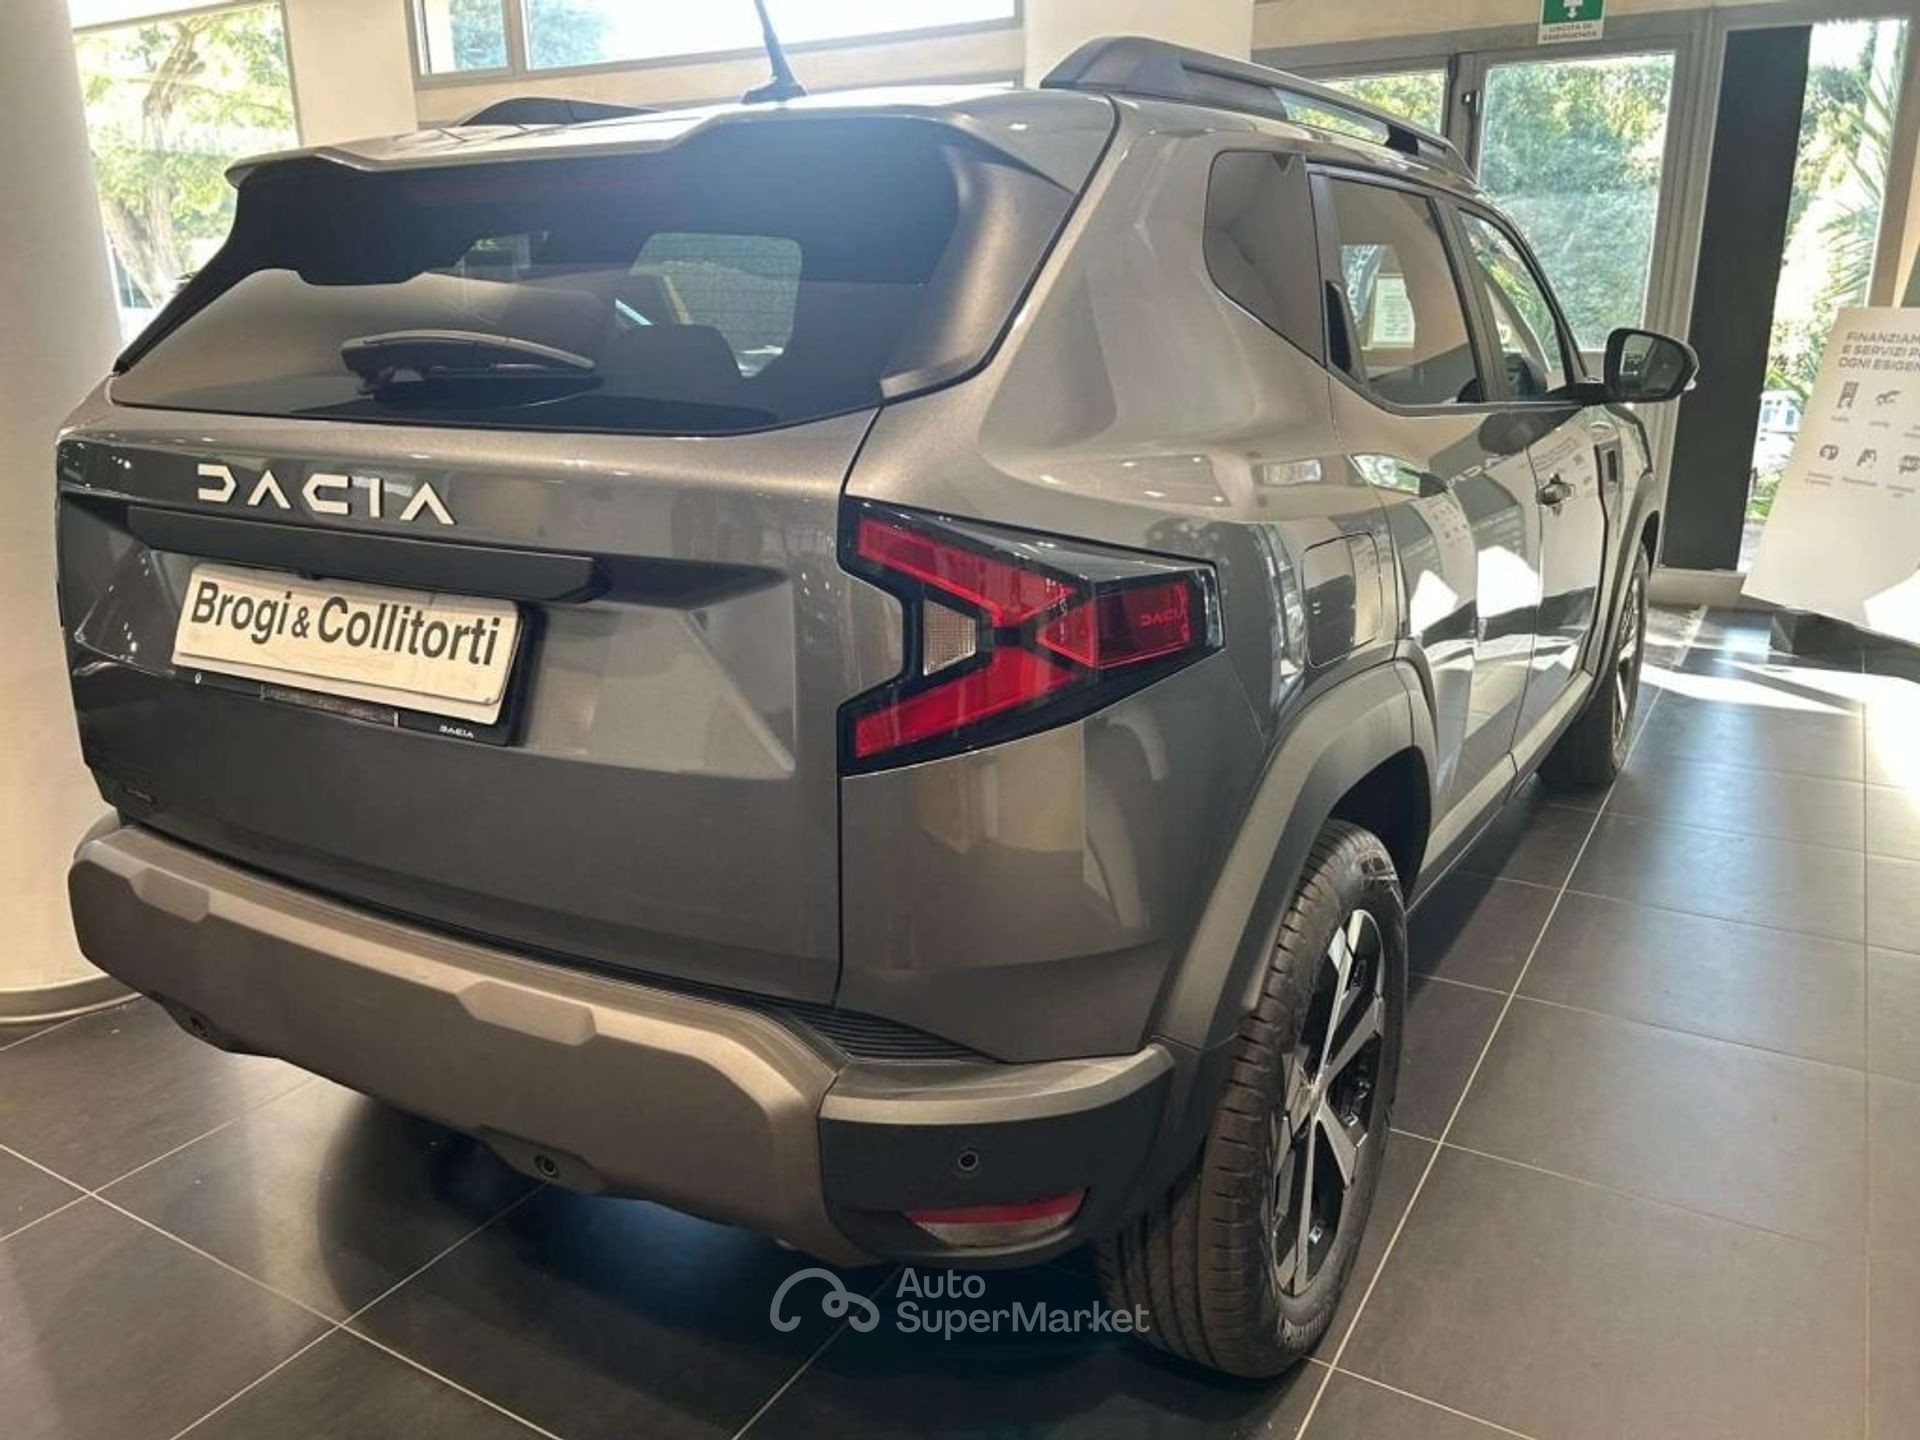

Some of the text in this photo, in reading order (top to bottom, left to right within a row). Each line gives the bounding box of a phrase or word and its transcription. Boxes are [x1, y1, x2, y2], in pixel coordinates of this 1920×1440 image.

[1842, 344, 1852, 354] E
[1853, 345, 1907, 358] SERVIZI
[1838, 356, 1871, 369] OGNI
[197, 463, 455, 526] DACIA
[191, 581, 501, 666] Brogi & Collitorti
[439, 725, 474, 739] DACIA
